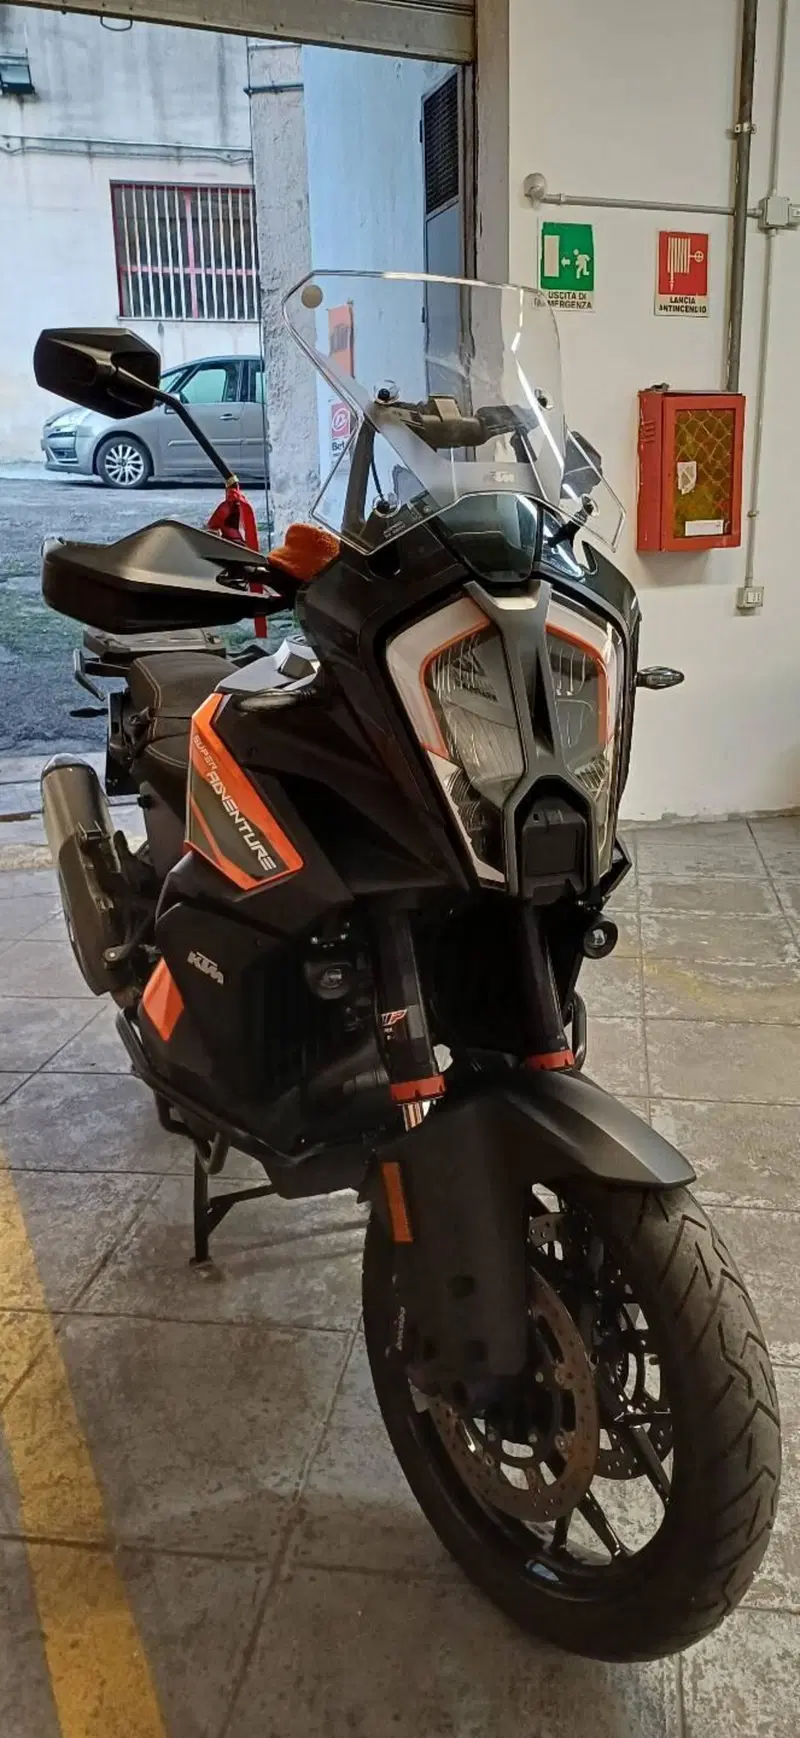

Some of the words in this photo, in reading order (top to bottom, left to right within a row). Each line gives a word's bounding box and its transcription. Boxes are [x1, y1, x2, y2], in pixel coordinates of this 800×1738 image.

[549, 291, 576, 300] USCITA
[579, 292, 587, 300] DI
[670, 296, 696, 305] LANCIA
[543, 299, 592, 309] MERGENZA
[659, 304, 707, 314] ANTINCENDIO
[193, 734, 217, 770] SUPER
[206, 772, 277, 871] ADVENTURE
[187, 950, 224, 985] KTM
